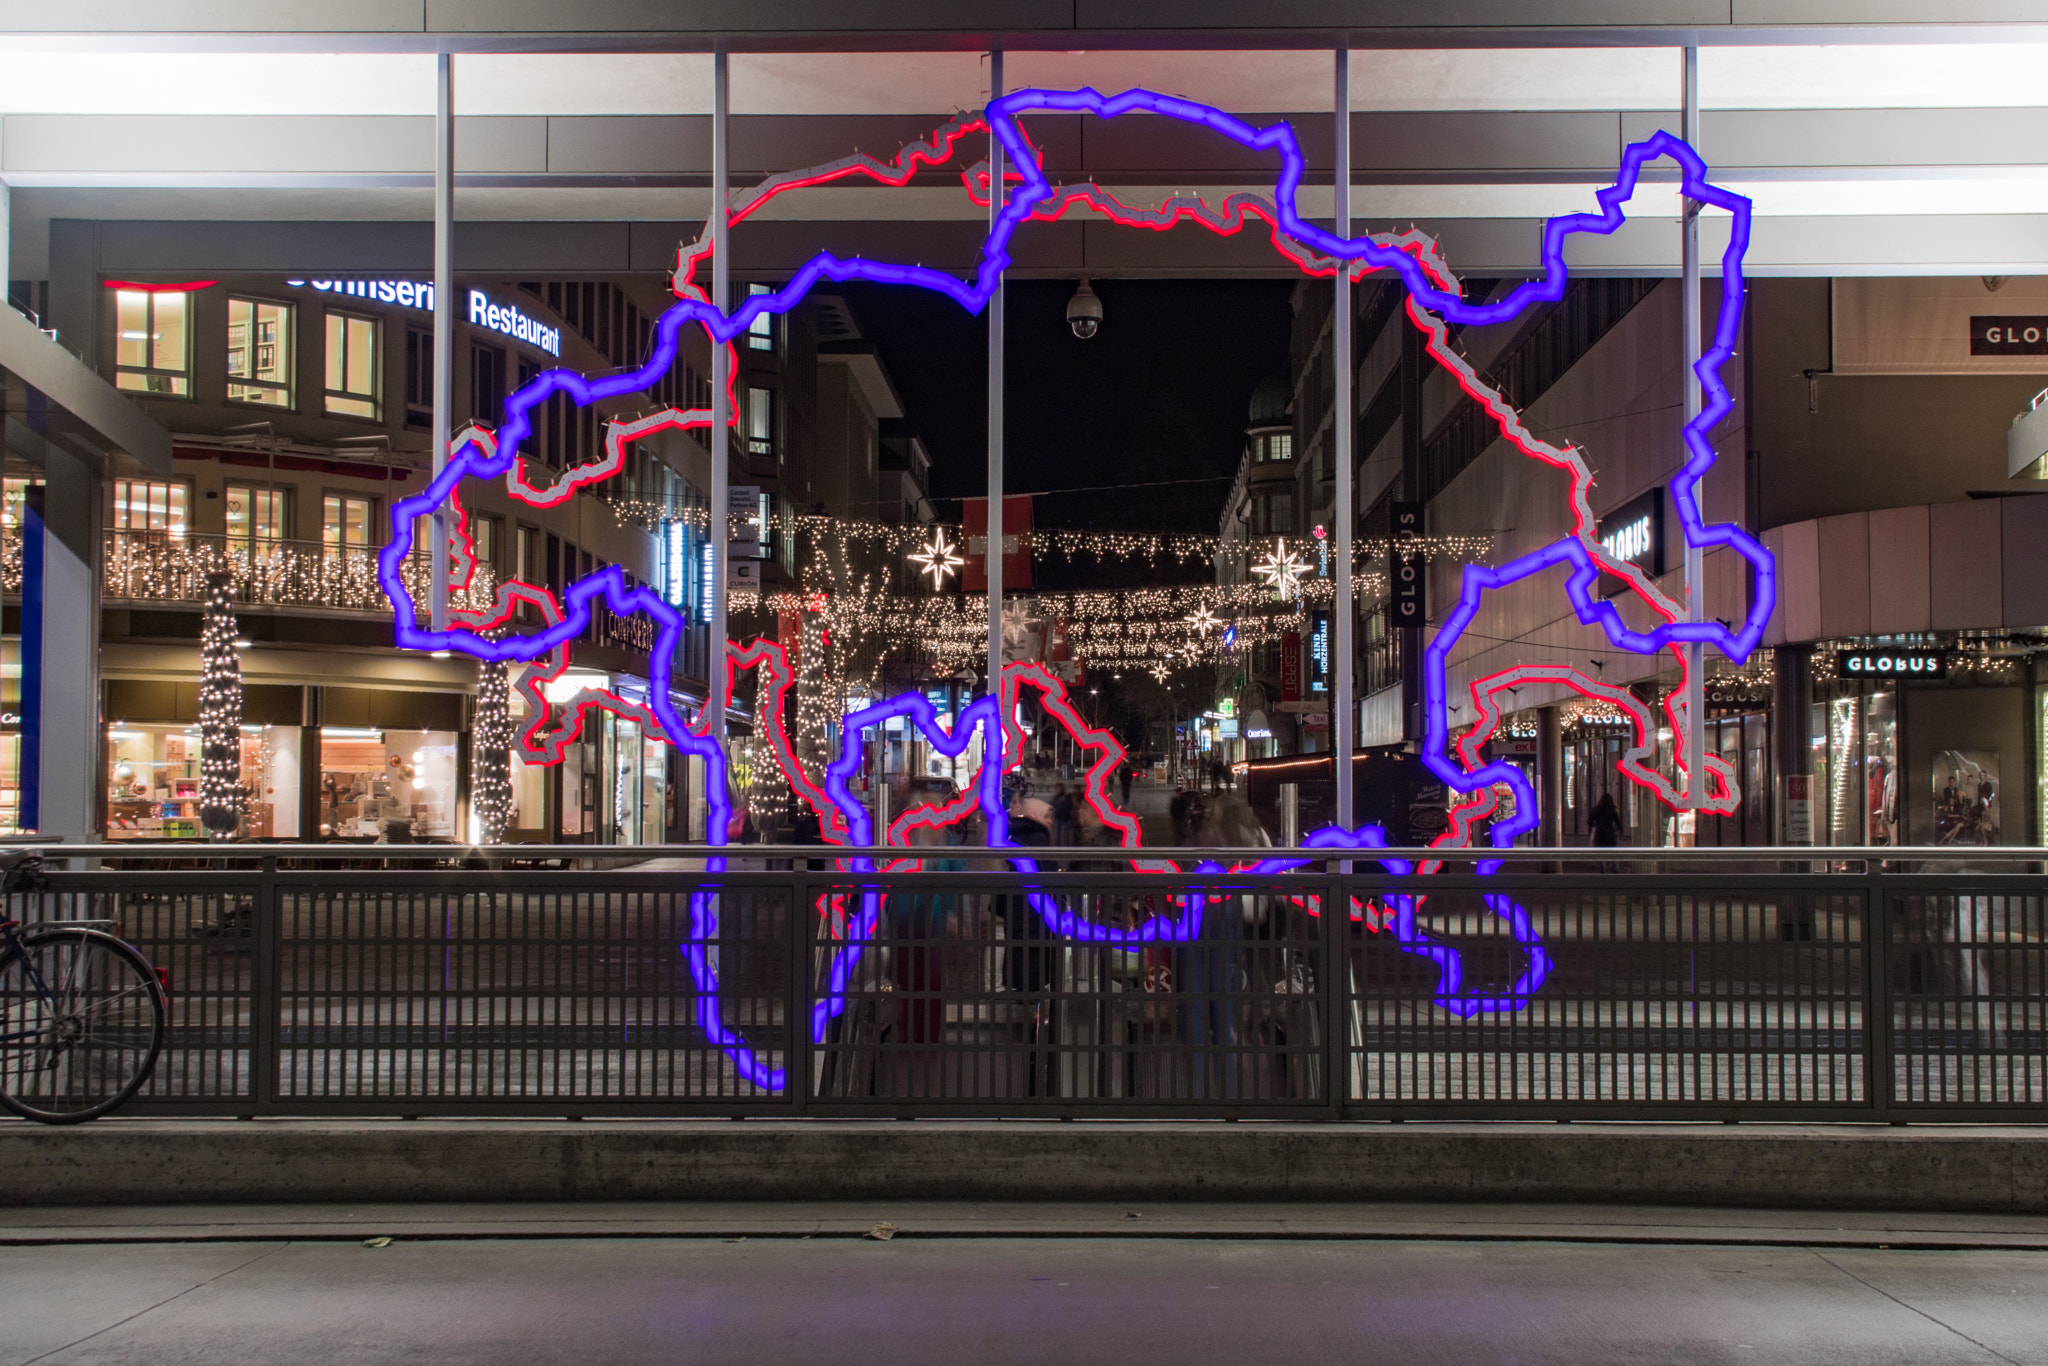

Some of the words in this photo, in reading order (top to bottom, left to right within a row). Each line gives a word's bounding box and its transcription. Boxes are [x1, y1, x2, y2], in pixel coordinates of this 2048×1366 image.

[470, 289, 560, 357] Restaurant
[1986, 327, 2048, 343] GLO
[1602, 515, 1650, 561] LOBUS
[703, 543, 713, 622] intimissimi
[1313, 633, 1321, 659] KIND
[1285, 647, 1297, 693] ESPRIT
[1848, 657, 1938, 671] GLOBUS
[1705, 692, 1759, 702] OBUS
[1583, 715, 1631, 724] GLOBU
[1512, 728, 1537, 738] GLO
[1515, 743, 1528, 751] ex
[1791, 783, 1808, 793] 30
